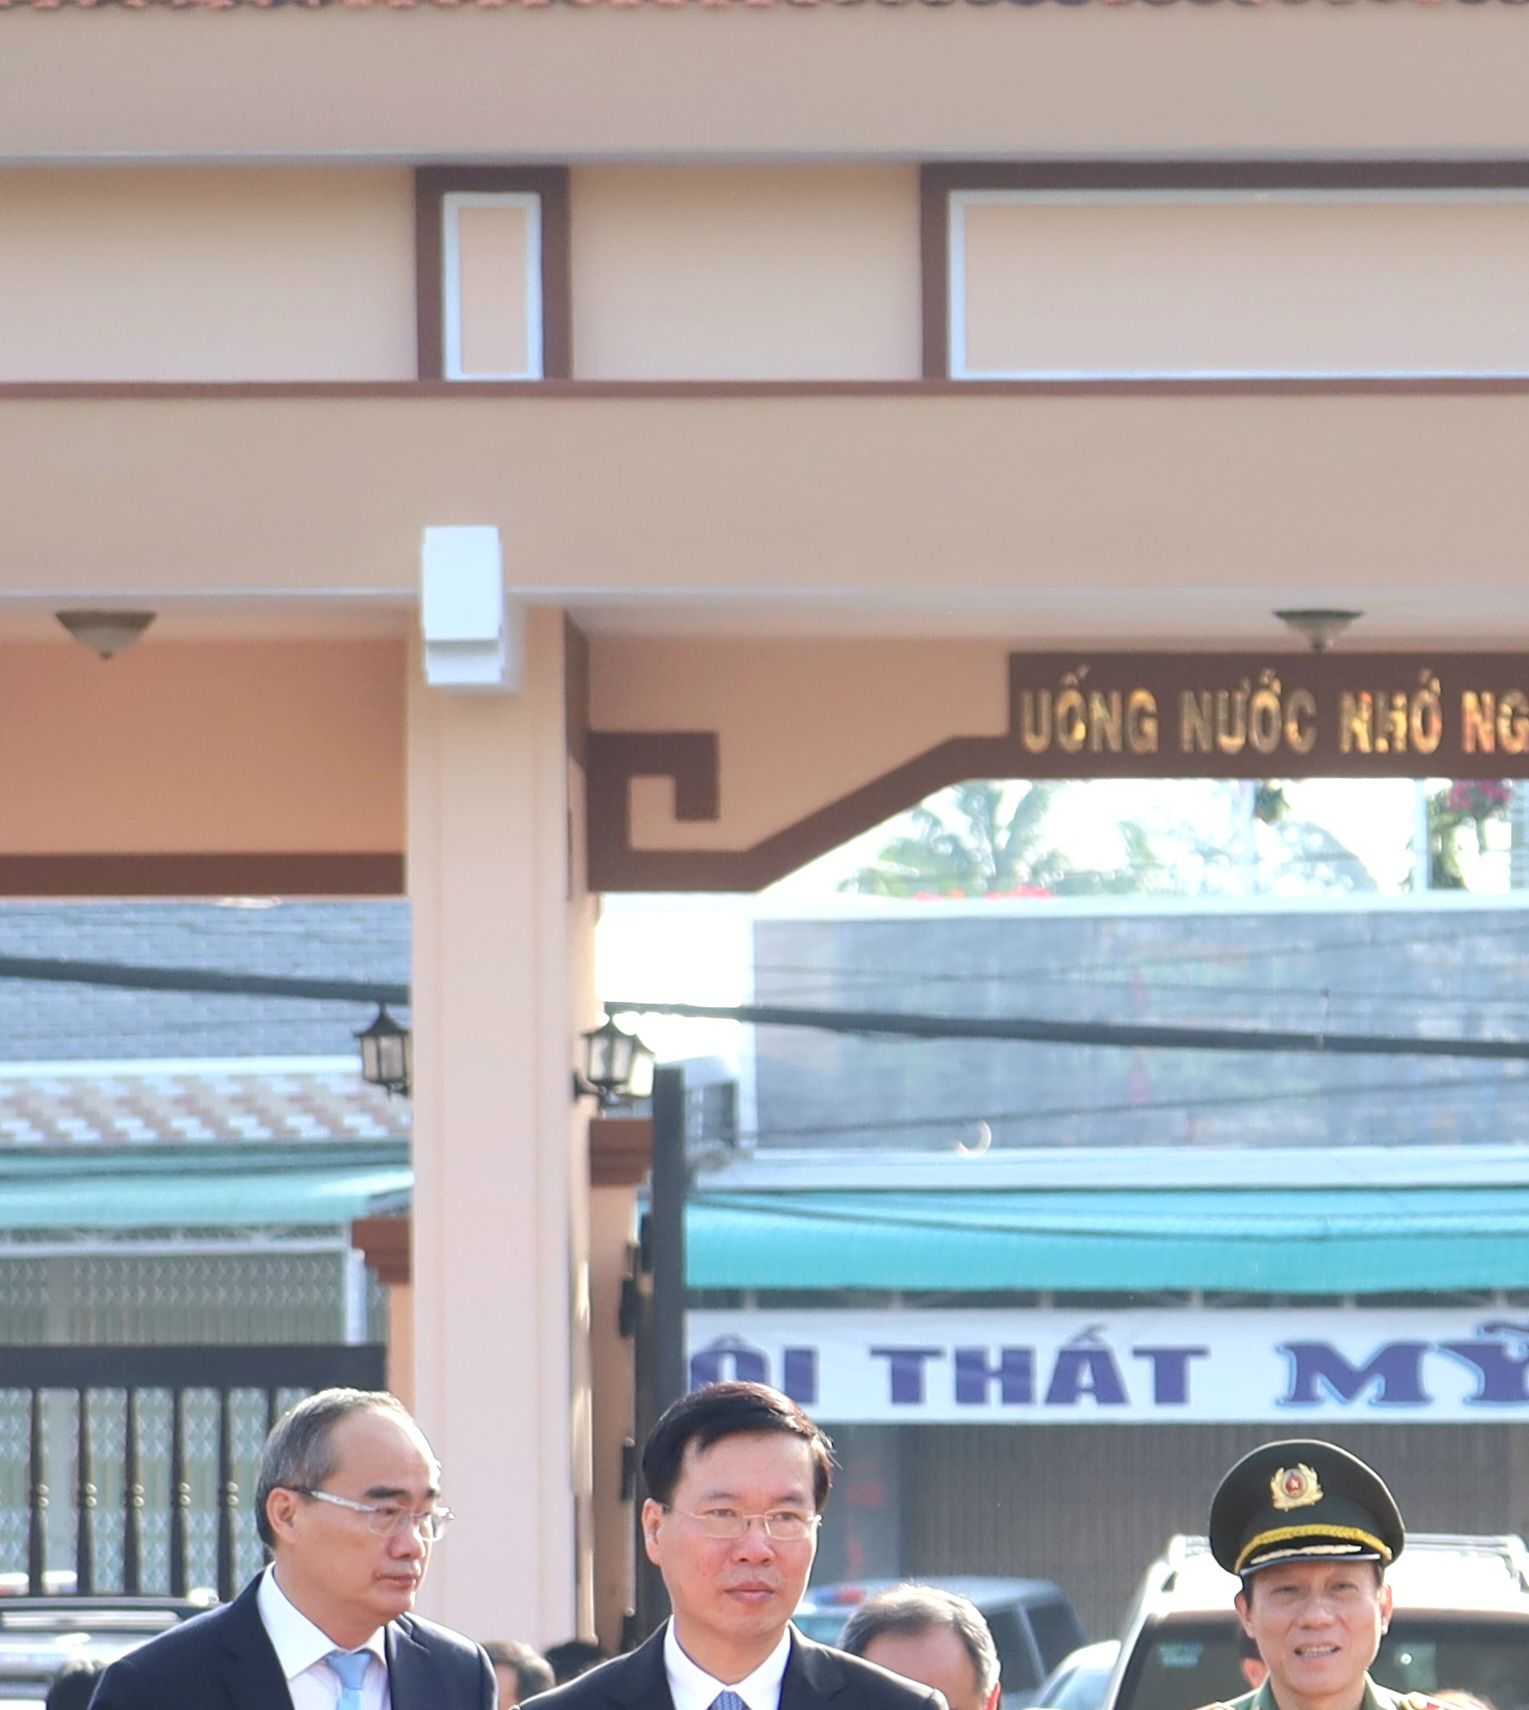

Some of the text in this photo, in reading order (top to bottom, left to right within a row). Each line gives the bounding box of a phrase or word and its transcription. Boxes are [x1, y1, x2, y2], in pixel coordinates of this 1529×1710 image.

[1020, 665, 1160, 754] UỐNG
[1180, 667, 1319, 754] NƯỚC
[1338, 669, 1444, 754] NHỚ
[870, 1325, 1210, 1406] THẤT
